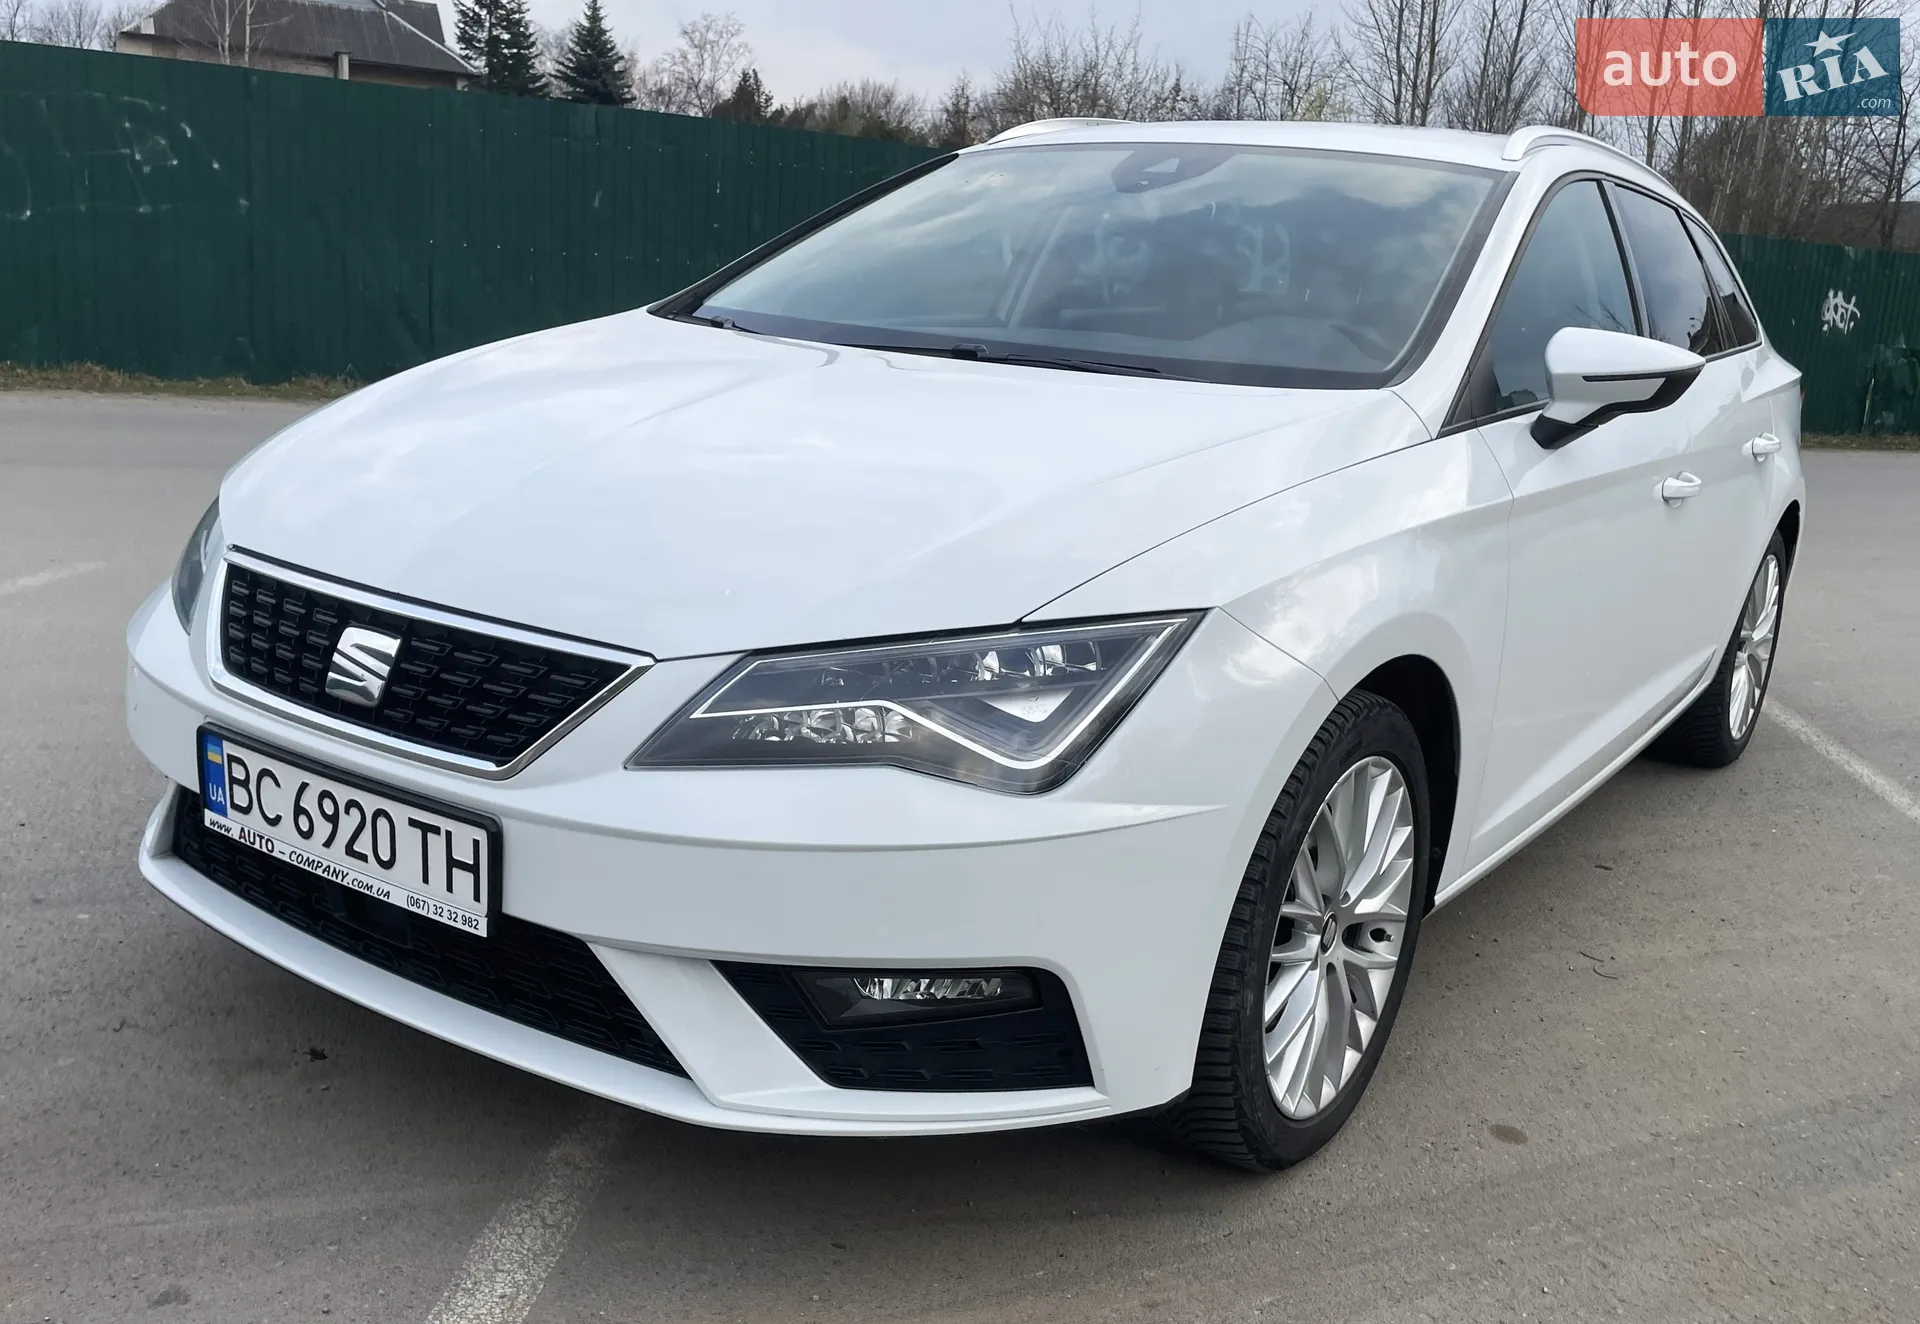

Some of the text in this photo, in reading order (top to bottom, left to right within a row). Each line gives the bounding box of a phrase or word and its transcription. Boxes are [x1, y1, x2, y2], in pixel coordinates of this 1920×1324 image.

[208, 783, 225, 805] UA
[226, 753, 481, 903] BC 6920 TH
[238, 826, 275, 854] AUTO
[406, 894, 480, 931] (067) 32 32 982
